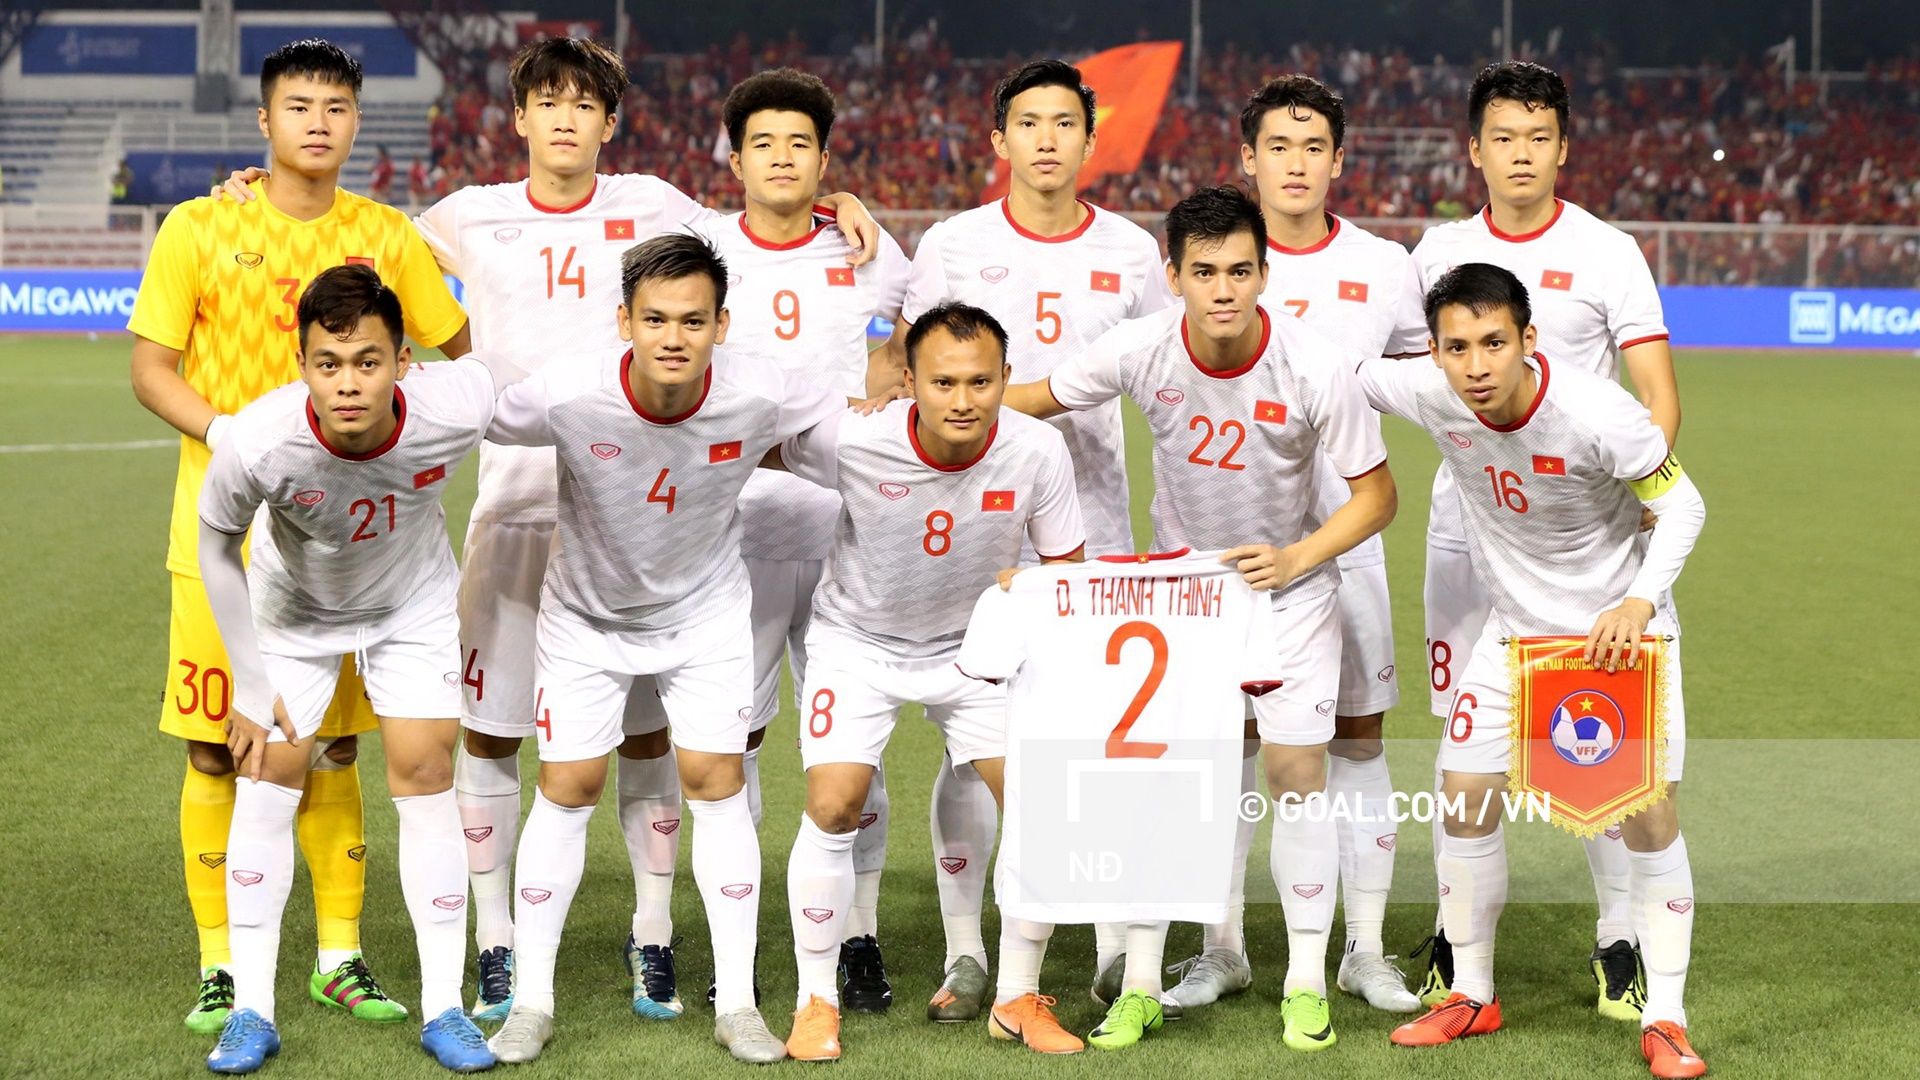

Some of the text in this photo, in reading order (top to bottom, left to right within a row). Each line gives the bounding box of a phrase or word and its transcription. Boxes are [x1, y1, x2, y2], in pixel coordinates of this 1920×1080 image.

[540, 246, 585, 299] 14
[0, 282, 137, 315] MEGAWO
[773, 290, 800, 340] 9
[1036, 291, 1062, 344] 5
[1187, 415, 1246, 471] 22
[646, 467, 677, 513] 4
[1484, 465, 1529, 514] 16
[349, 494, 396, 542] 21
[922, 509, 954, 557] 8
[1056, 576, 1223, 618] D. THANH THINH
[176, 658, 230, 722] 30
[535, 687, 552, 742] 4
[809, 688, 835, 738] 8
[1105, 620, 1169, 759] 2
[1576, 746, 1598, 755] VFF
